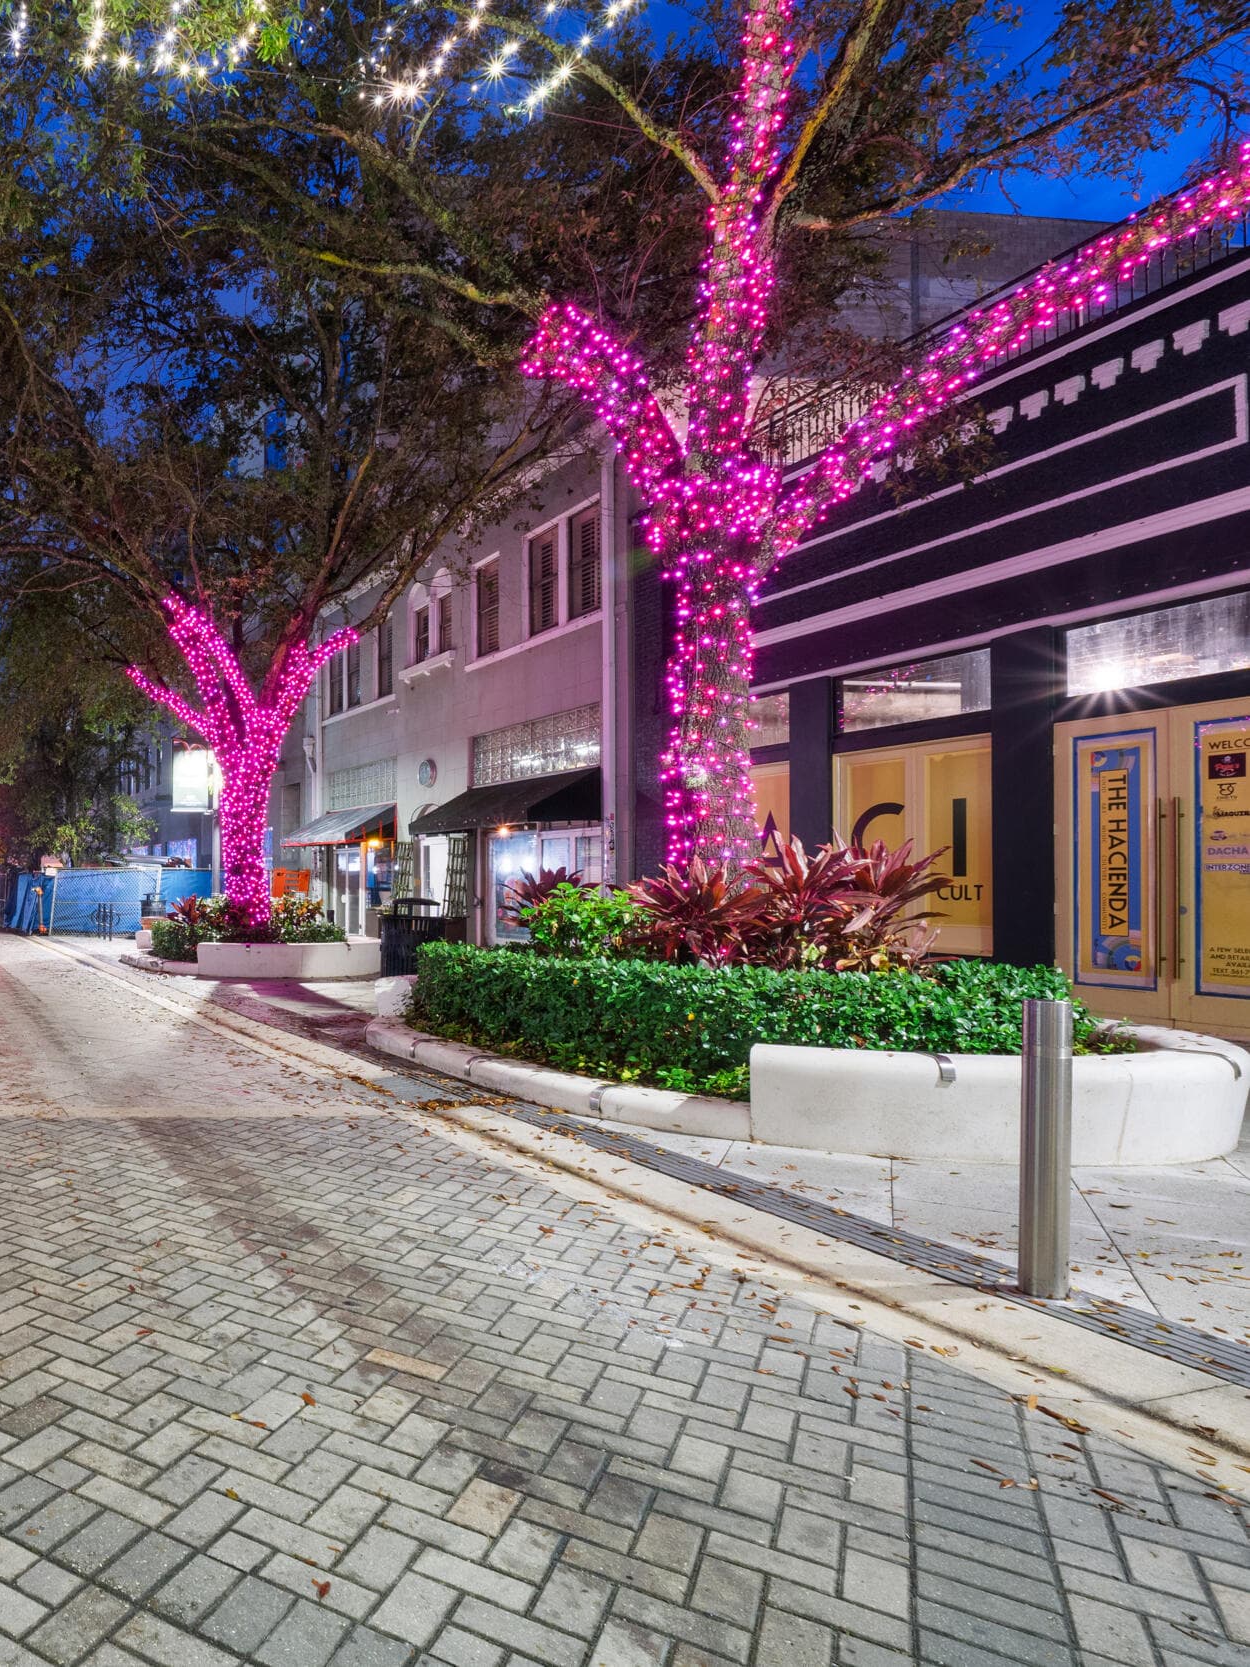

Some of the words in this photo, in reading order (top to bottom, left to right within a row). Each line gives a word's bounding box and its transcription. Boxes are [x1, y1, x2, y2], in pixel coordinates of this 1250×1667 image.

[1108, 774, 1127, 811] THE
[1207, 847, 1248, 856] DACHA
[1108, 819, 1127, 929] HACIENDA
